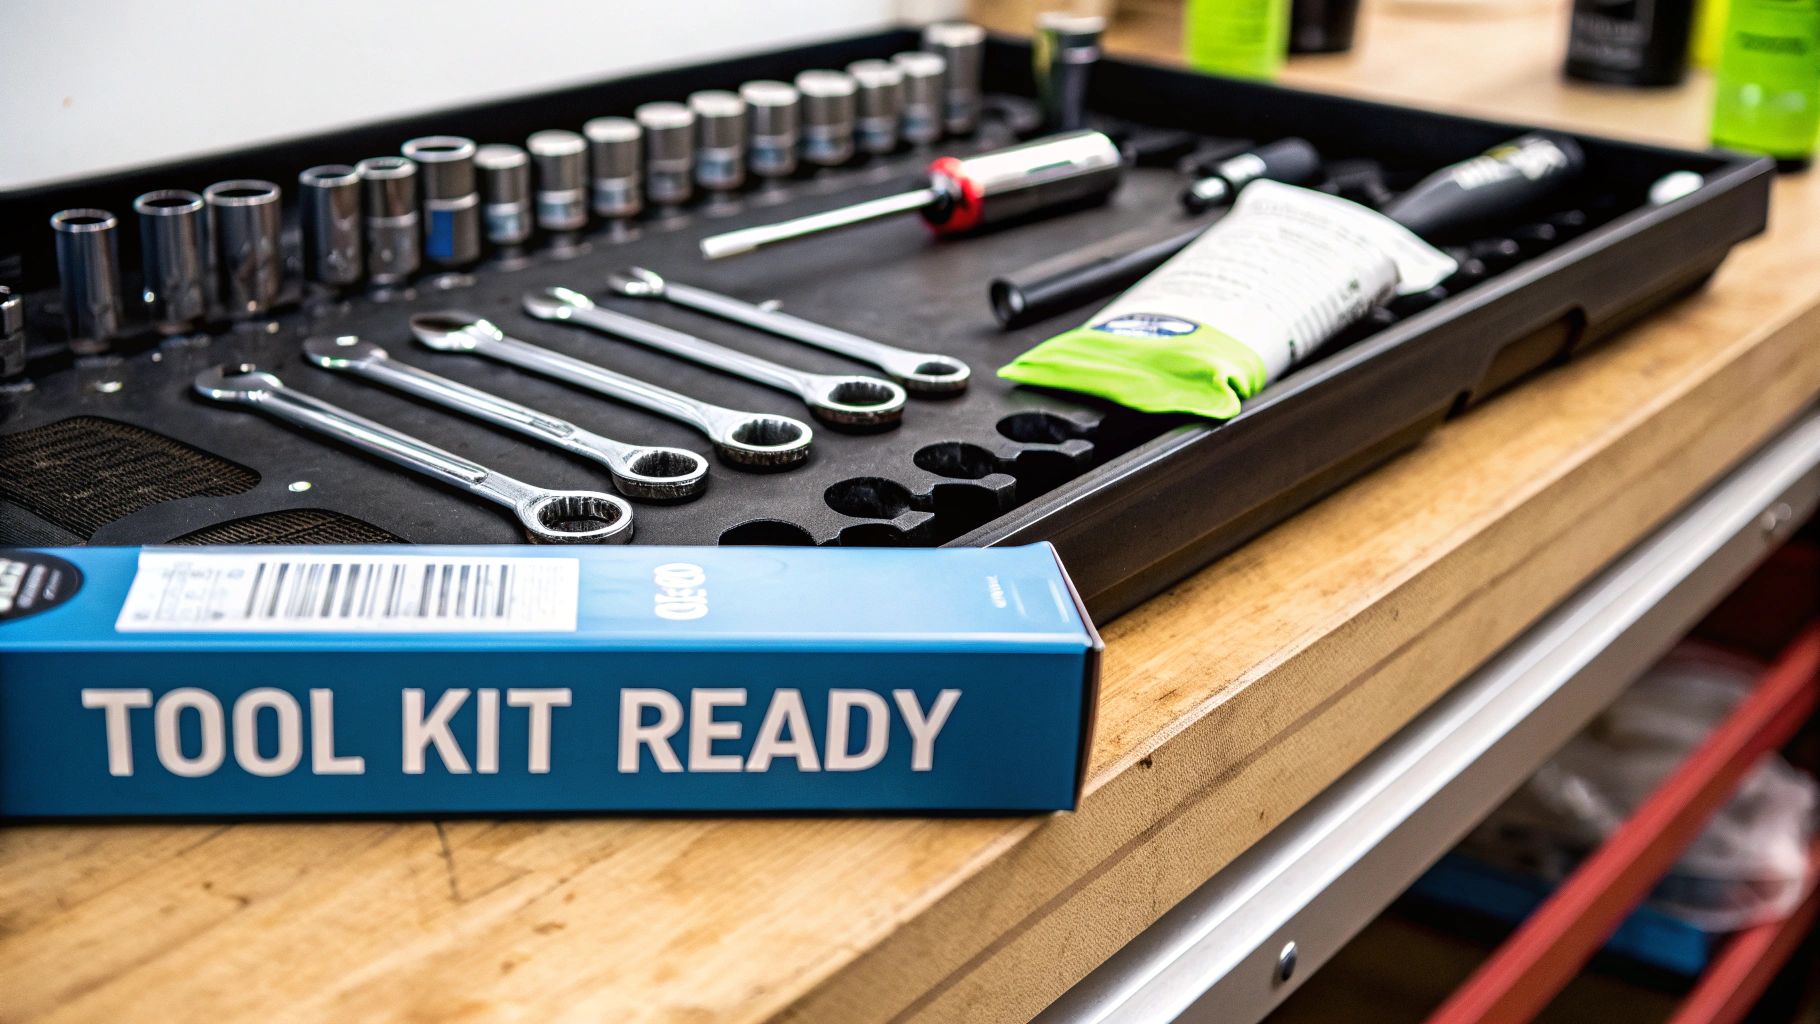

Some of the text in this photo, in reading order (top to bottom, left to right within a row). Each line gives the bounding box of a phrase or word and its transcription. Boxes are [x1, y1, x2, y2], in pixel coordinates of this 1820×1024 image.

[81, 687, 962, 777] TOOL KIT READY
